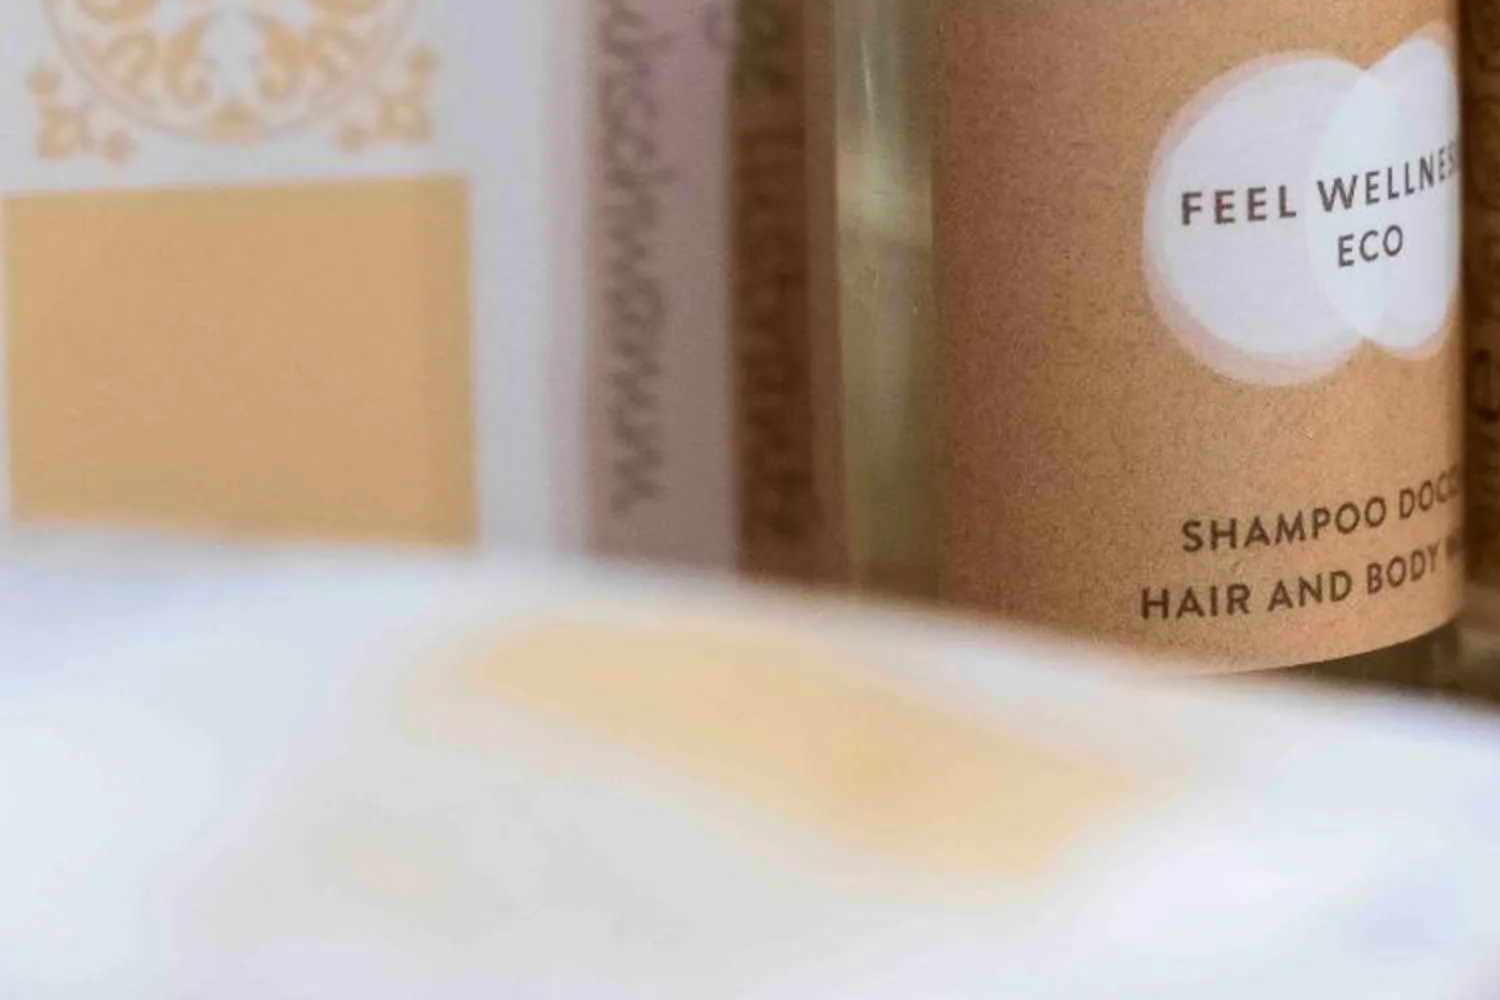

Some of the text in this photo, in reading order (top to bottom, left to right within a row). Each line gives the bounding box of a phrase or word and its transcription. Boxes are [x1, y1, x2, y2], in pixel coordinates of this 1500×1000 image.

[1181, 139, 1459, 226] FEEL WELLNES
[1337, 224, 1404, 268] ECO
[1182, 496, 1387, 552] SHAMPOO
[1398, 463, 1459, 520] DOCC
[1141, 583, 1250, 621] HAIR
[1267, 569, 1353, 613] AND
[1367, 537, 1441, 595] BODY
